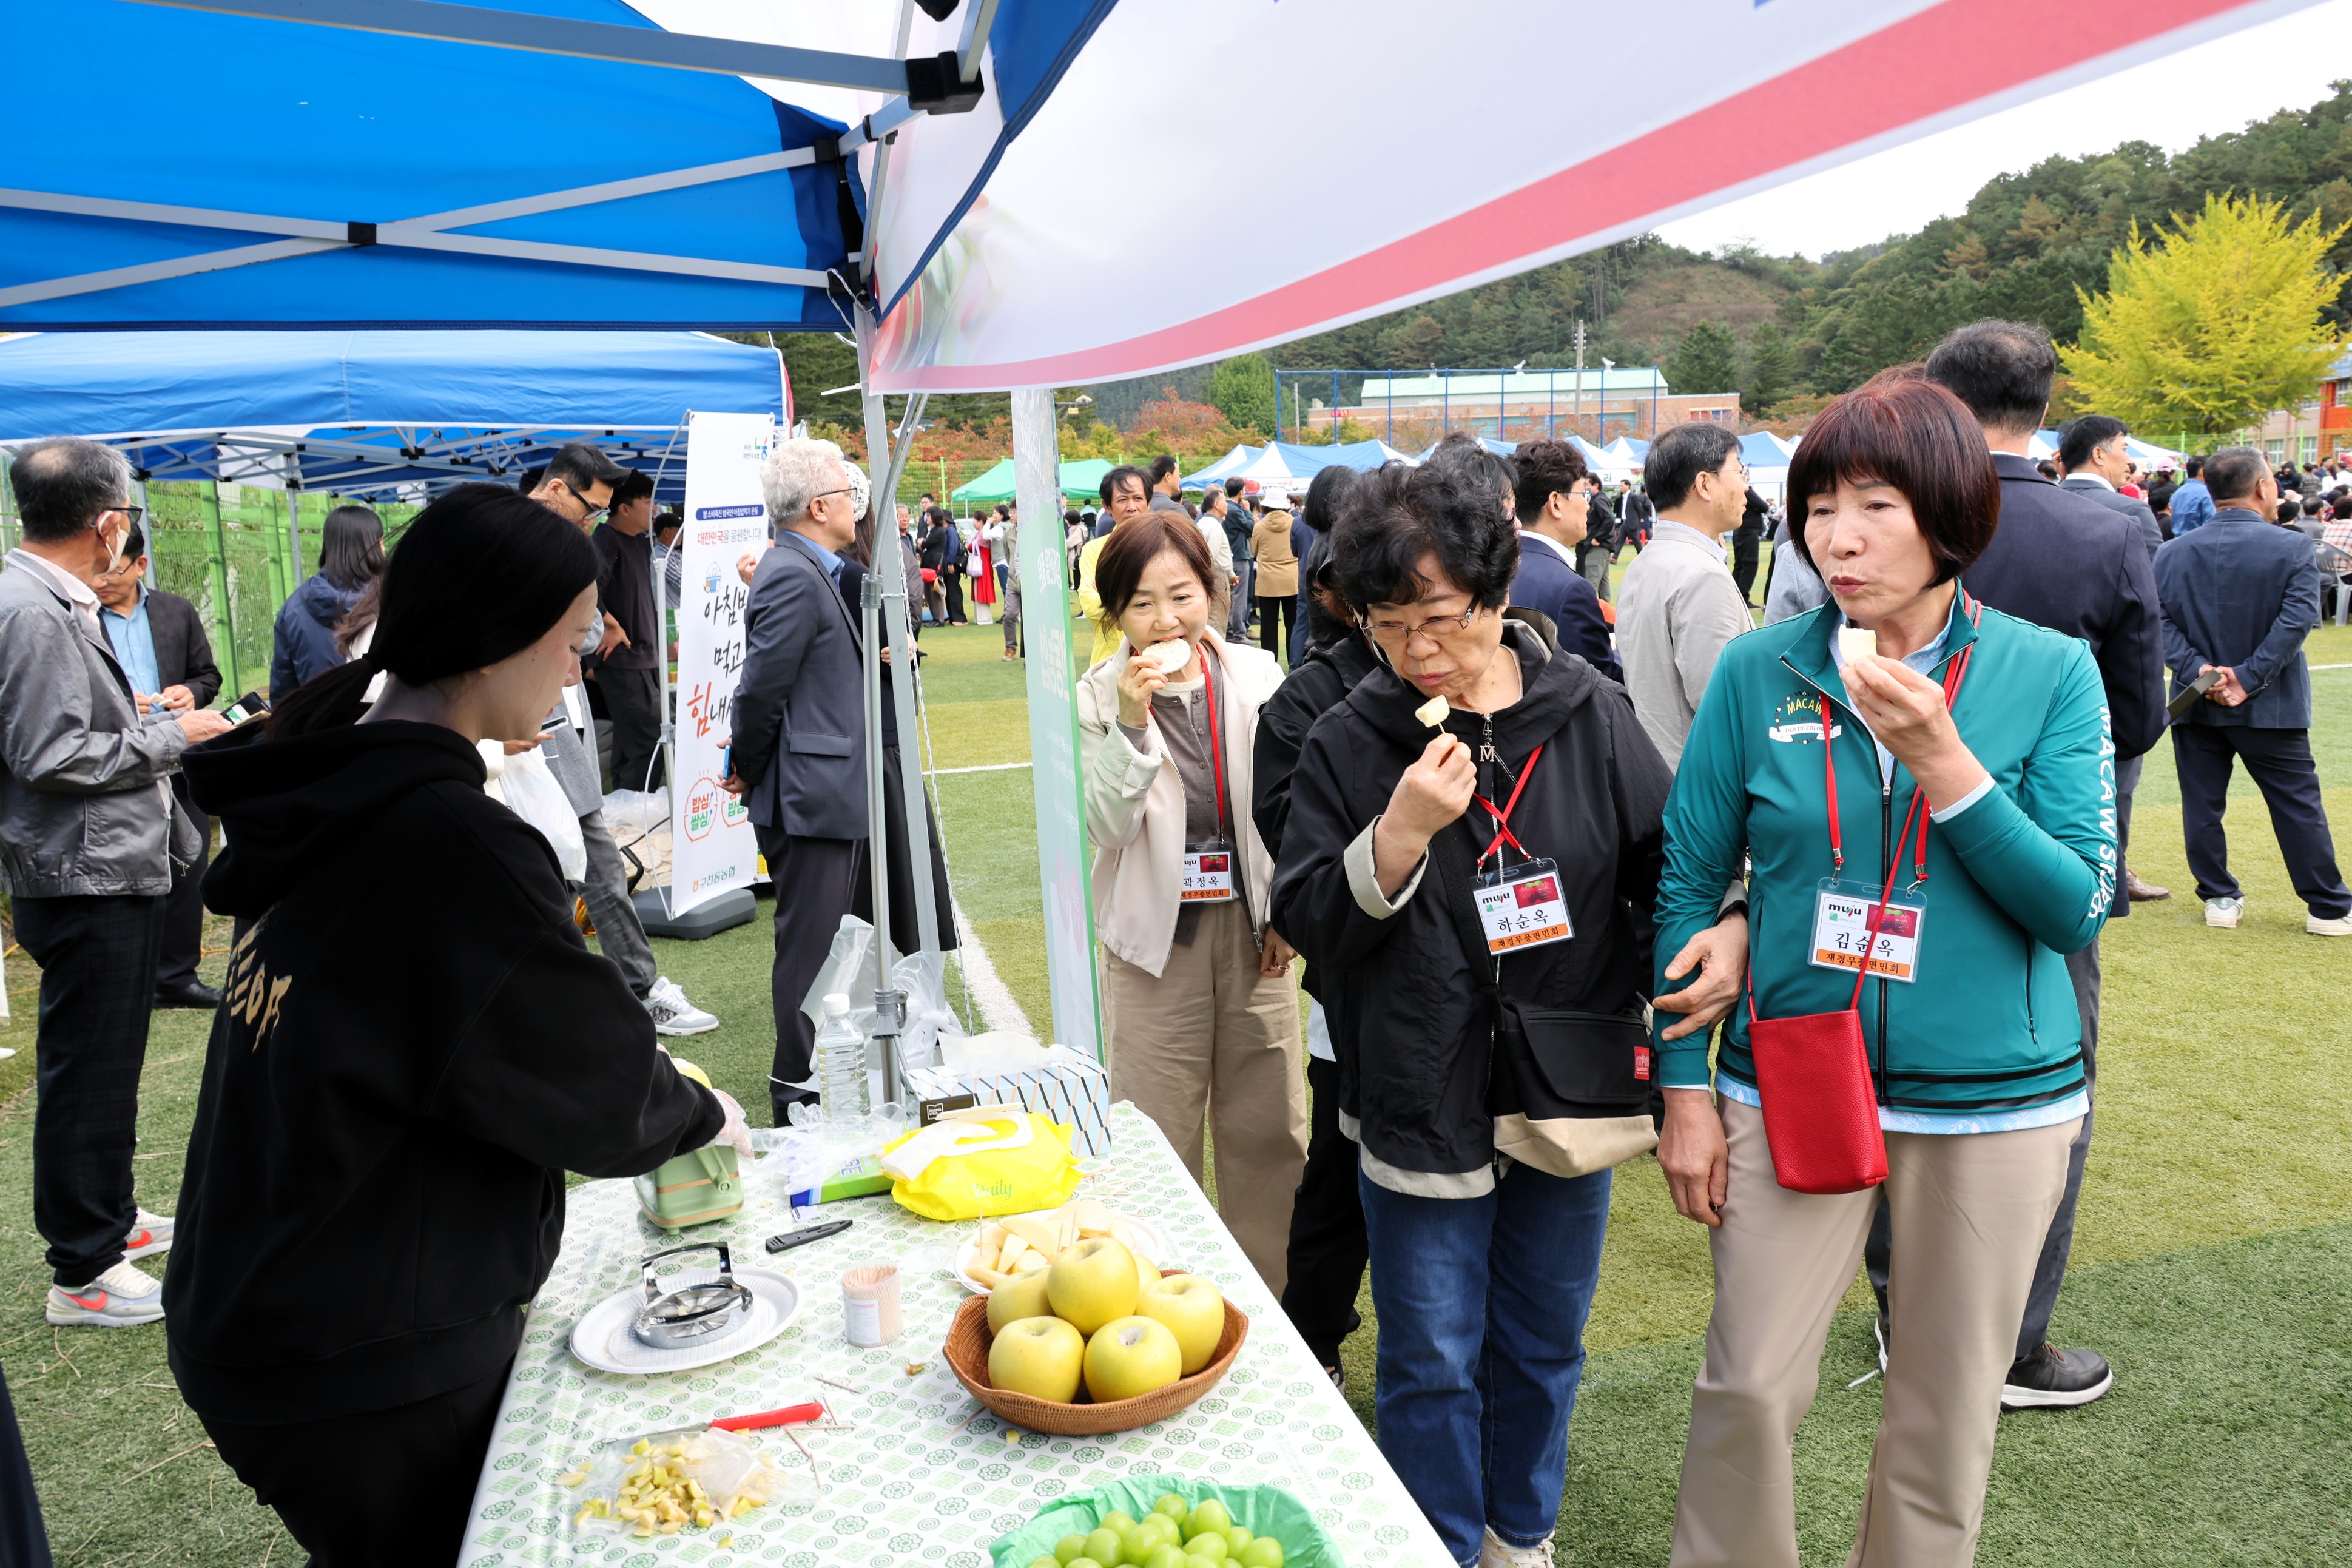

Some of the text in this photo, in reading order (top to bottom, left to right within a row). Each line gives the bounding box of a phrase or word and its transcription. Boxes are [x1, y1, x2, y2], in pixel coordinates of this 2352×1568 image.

[703, 506, 758, 519] 쌀 소비촉진 범국민 아침밥먹기 운동
[697, 527, 762, 546] 대한민국을 응원합니다!
[714, 640, 744, 679] 먹고
[1787, 698, 1822, 716] MACAW
[692, 793, 709, 814] 밥심
[2088, 707, 2117, 919] MACAW SPORTS
[690, 810, 708, 832] 쌀심
[1184, 858, 1196, 867] uju
[700, 866, 736, 889] 구천동농협
[1482, 891, 1511, 904] muju
[1497, 909, 1549, 933] 하순옥
[1828, 904, 1861, 917] muju
[1497, 927, 1560, 947] 재경무풍면민회
[1835, 932, 1894, 957] 김순옥
[971, 1179, 1012, 1200] Daily
